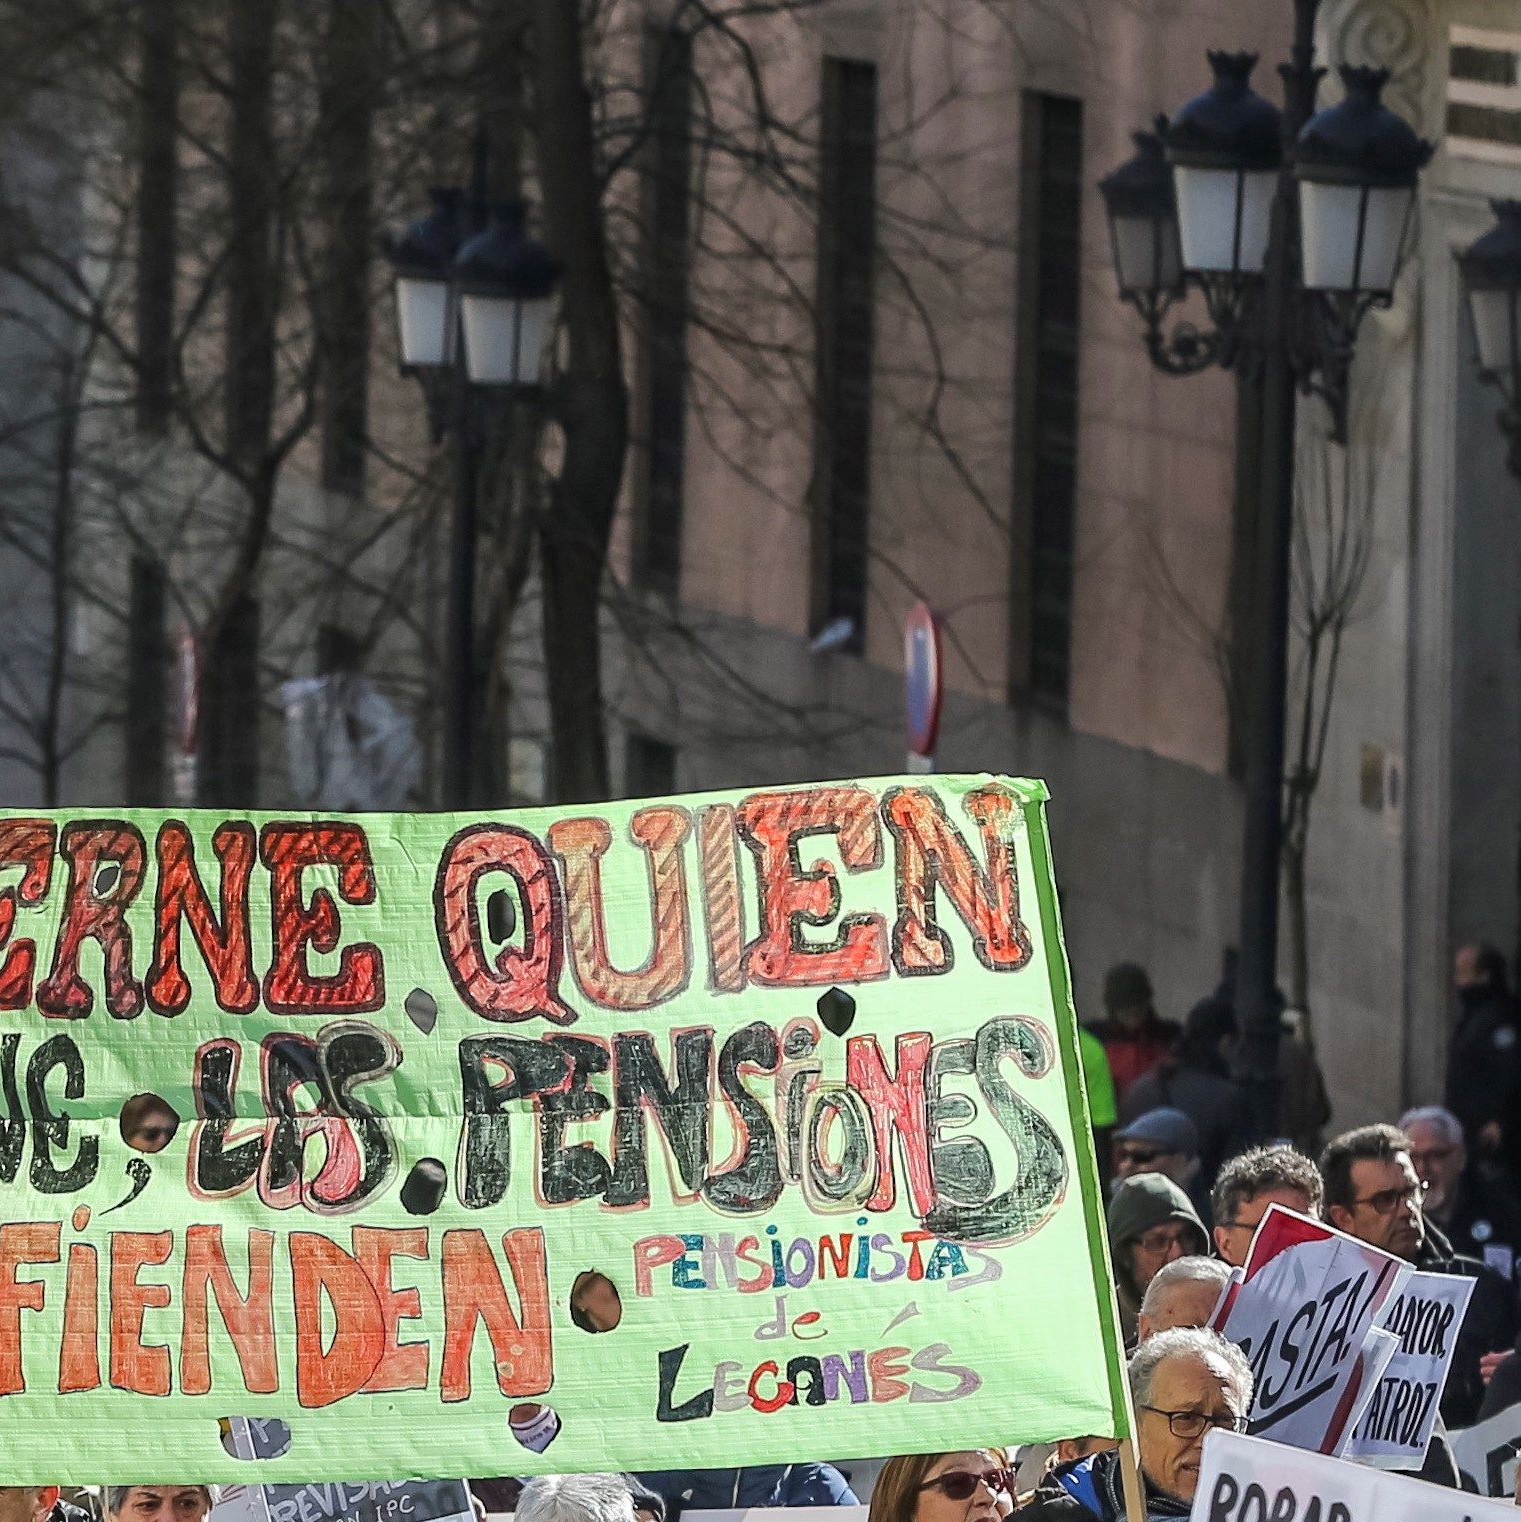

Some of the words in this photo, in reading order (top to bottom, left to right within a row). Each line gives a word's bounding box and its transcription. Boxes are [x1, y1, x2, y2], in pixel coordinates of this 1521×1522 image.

[435, 784, 1033, 1025] QUIEN
[188, 1019, 403, 1216] LAS
[752, 1296, 830, 1341] de
